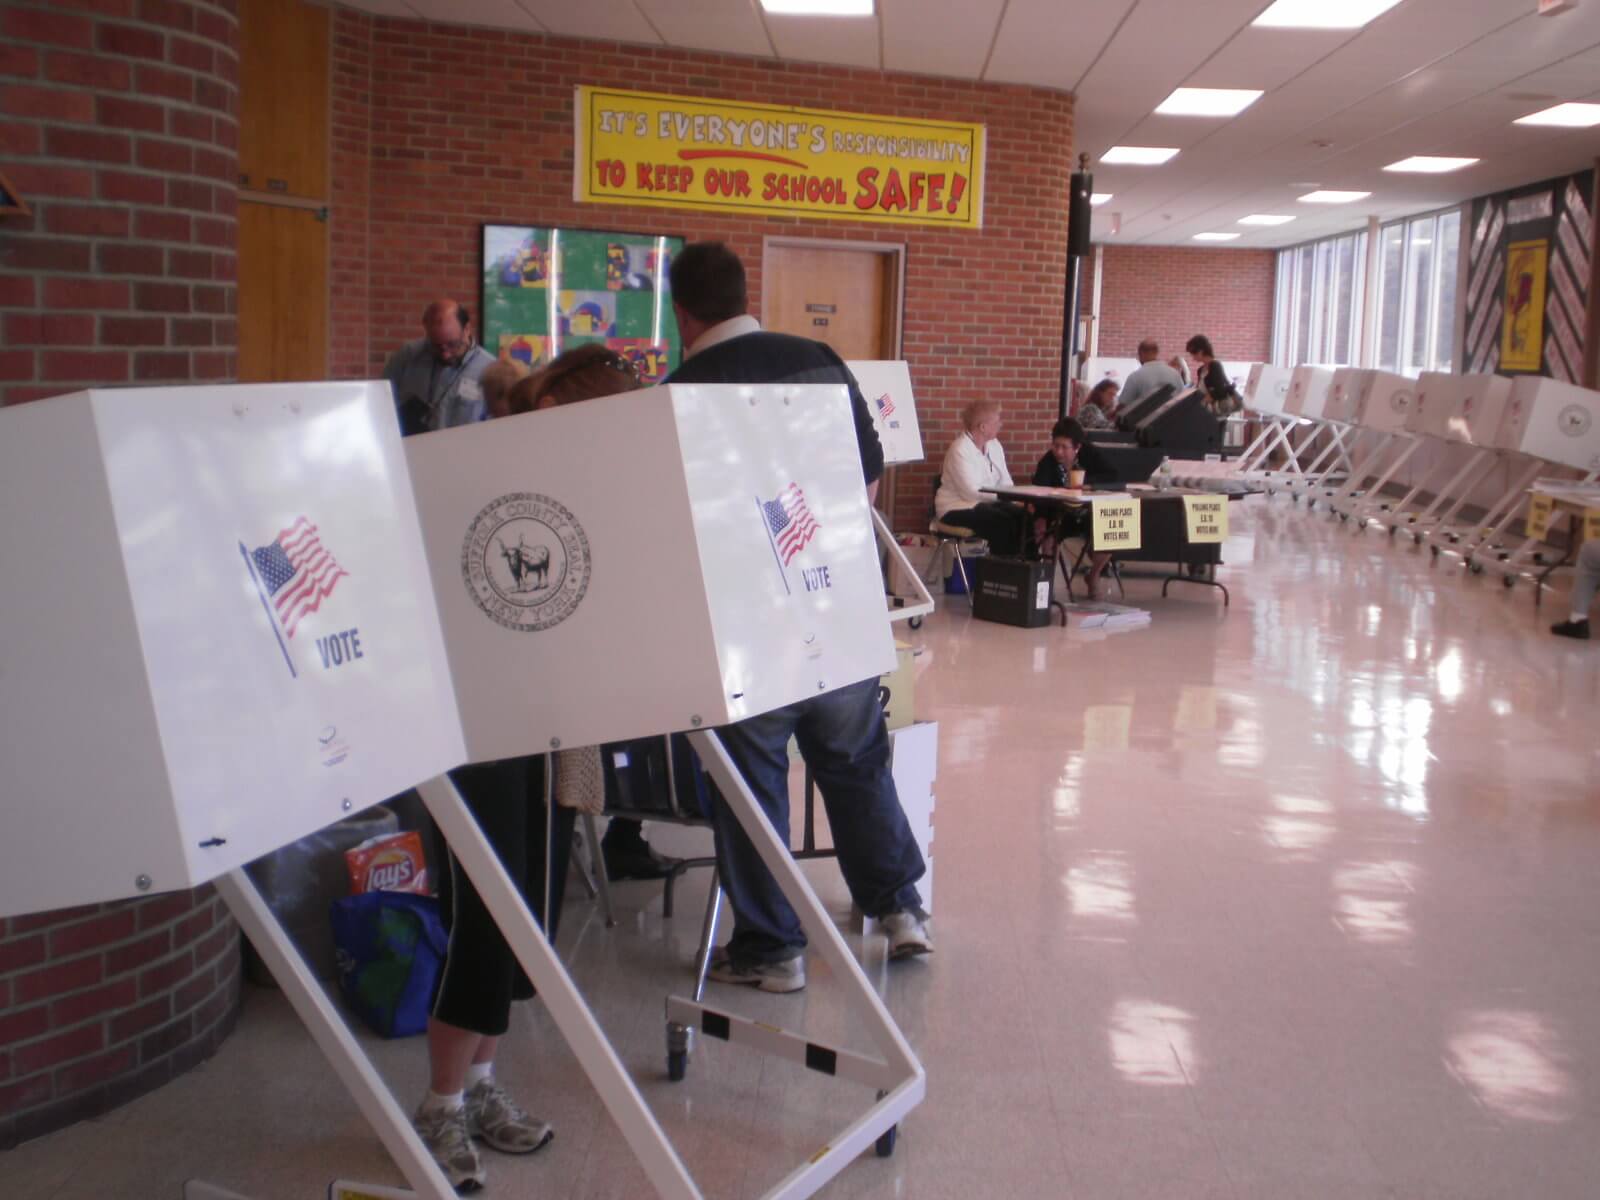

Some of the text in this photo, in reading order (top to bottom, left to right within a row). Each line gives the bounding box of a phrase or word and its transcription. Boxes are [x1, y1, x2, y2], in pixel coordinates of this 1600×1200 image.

[599, 110, 970, 163] IT'S EVERYONE'S RESPONSIBILITY
[596, 159, 967, 214] TO KEEP OUR SCHOOL SAFE!
[802, 566, 832, 592] VOTE
[316, 628, 363, 669] VOTE
